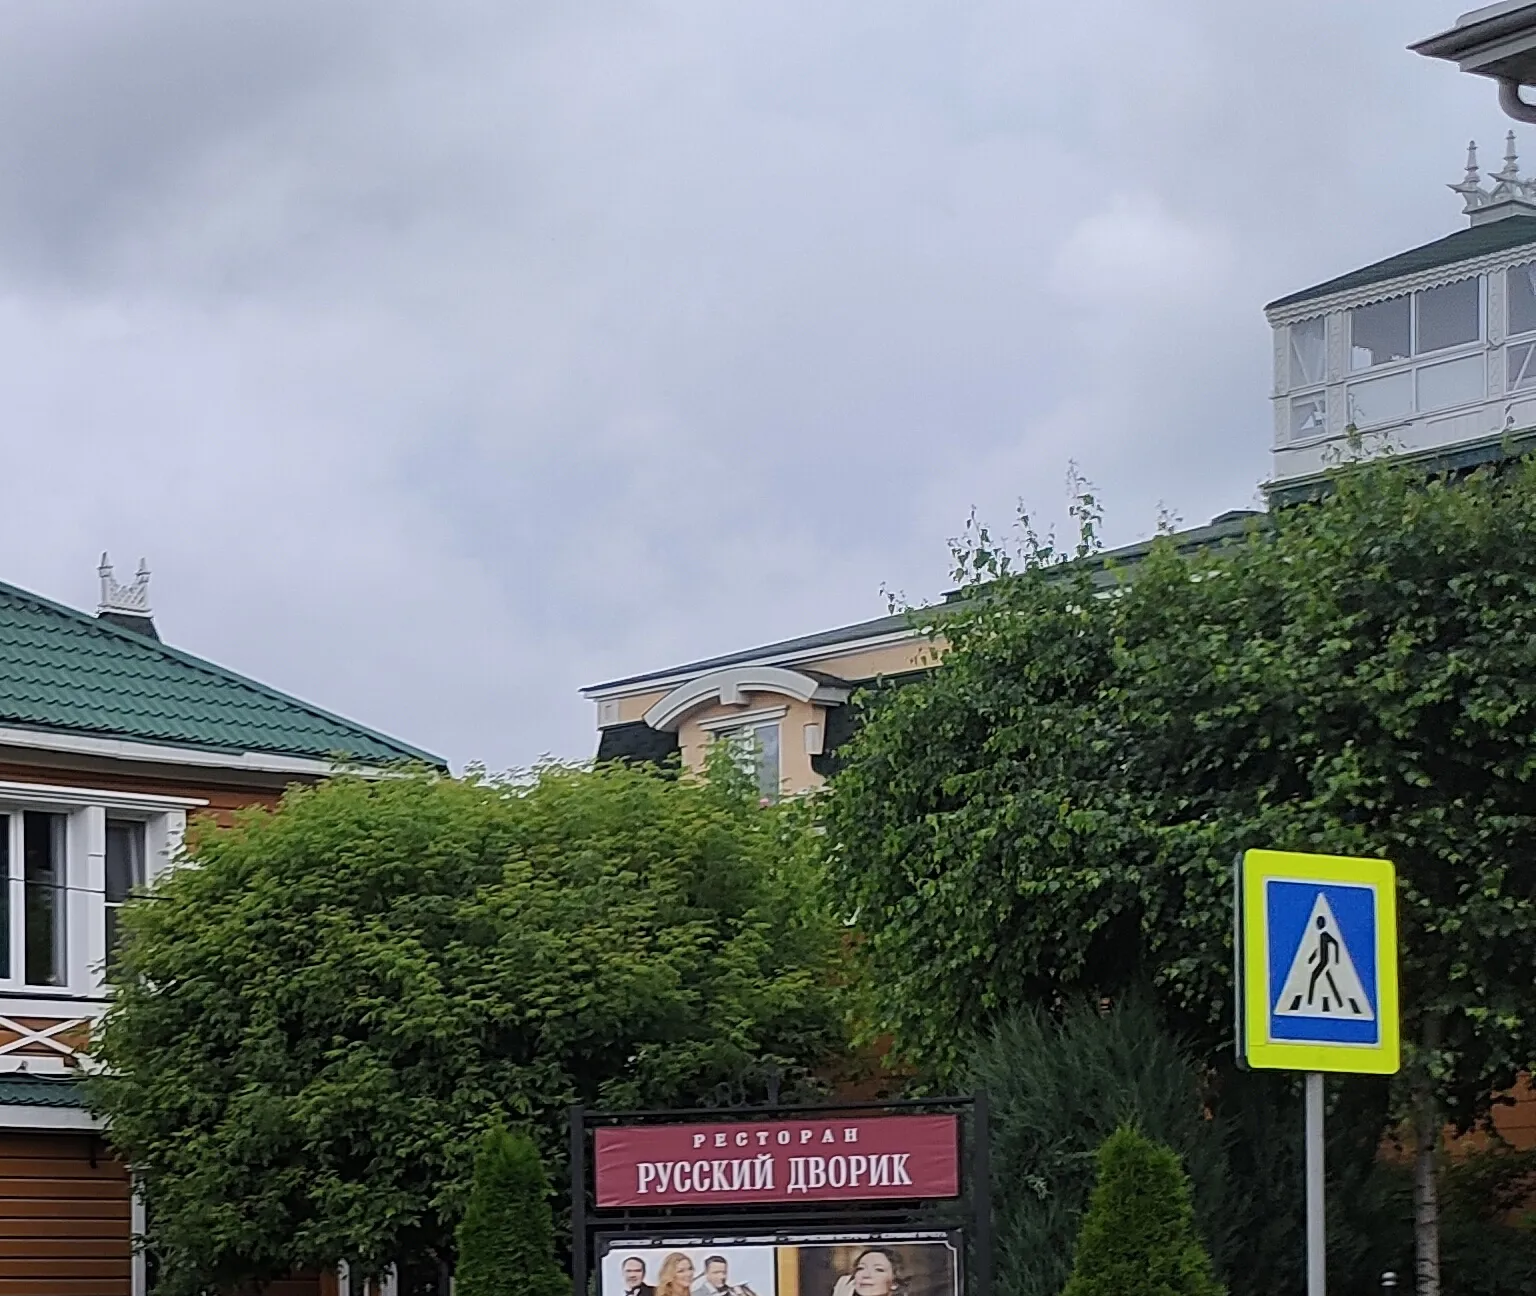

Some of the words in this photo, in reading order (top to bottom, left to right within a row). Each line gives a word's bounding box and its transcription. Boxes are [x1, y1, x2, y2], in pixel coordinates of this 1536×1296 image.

[692, 1127, 859, 1149] РЕСТОРАН
[635, 1154, 776, 1194] РУССКИЙ
[786, 1153, 913, 1194] ДВОРИК
